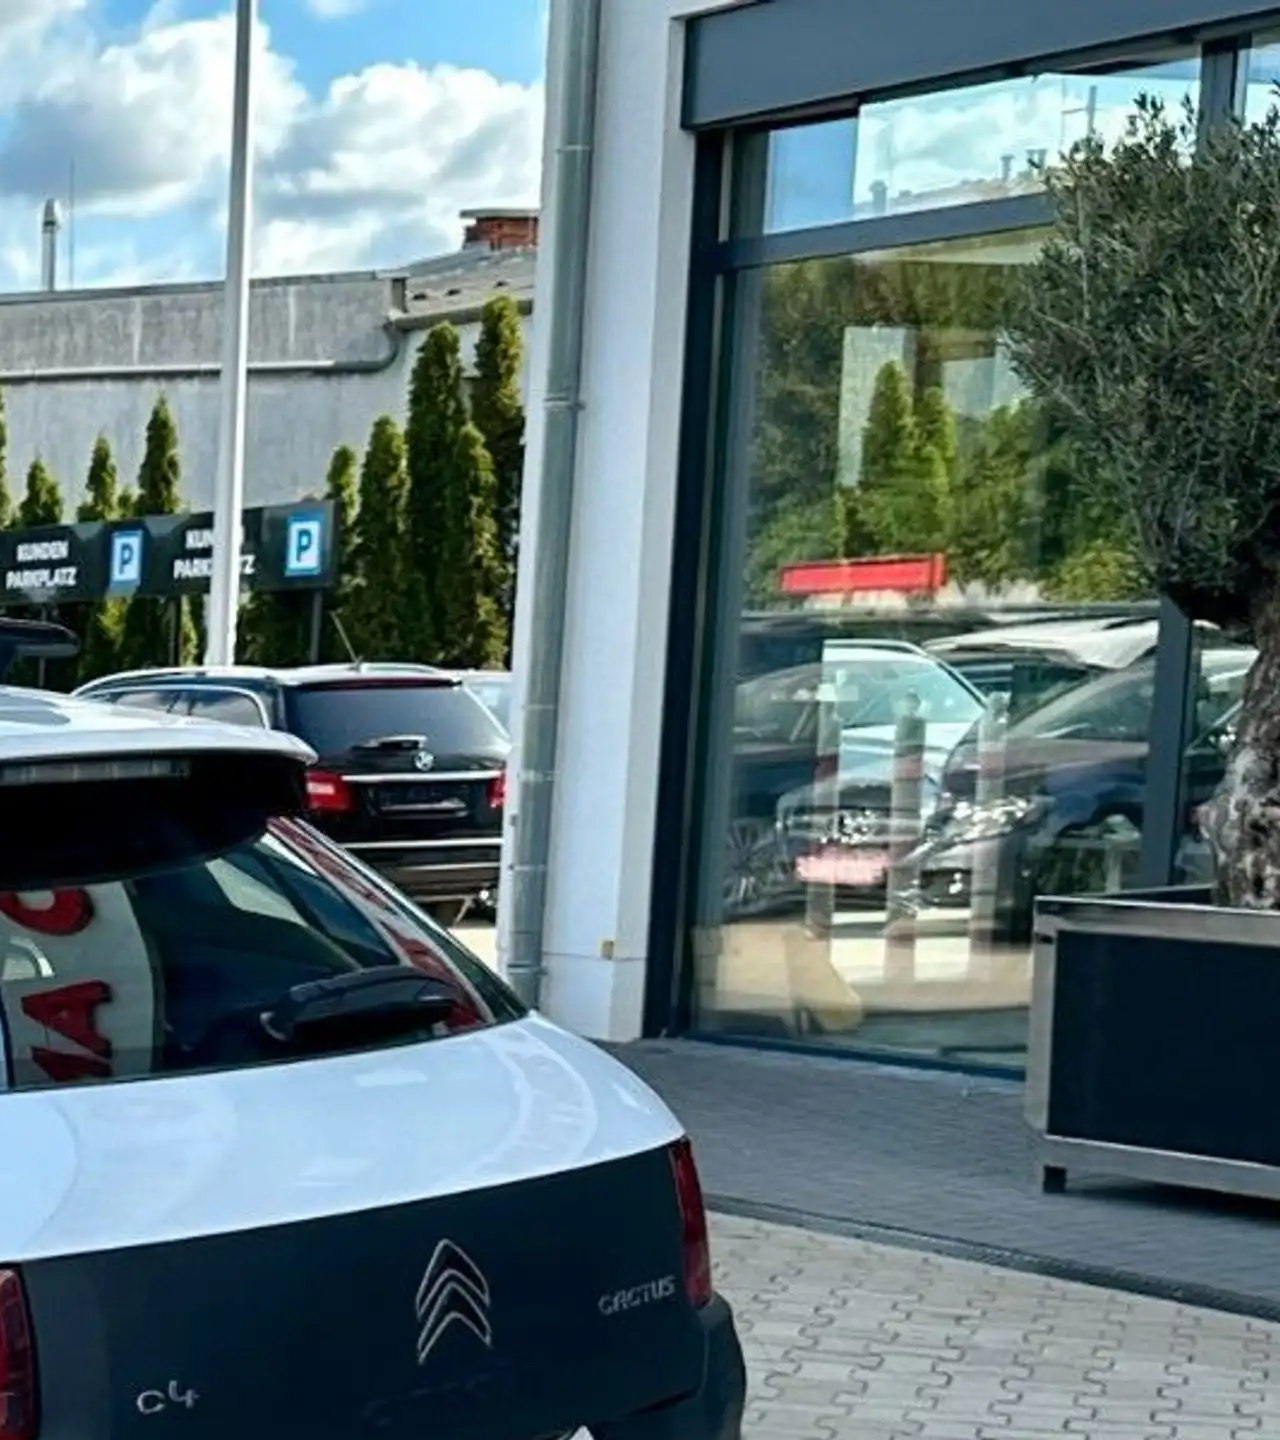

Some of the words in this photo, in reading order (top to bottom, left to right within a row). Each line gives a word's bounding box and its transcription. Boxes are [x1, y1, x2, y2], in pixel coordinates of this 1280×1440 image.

[16, 540, 69, 562] KUNDEN
[6, 566, 77, 590] PARKPLATZ
[597, 1274, 678, 1316] CACTUS
